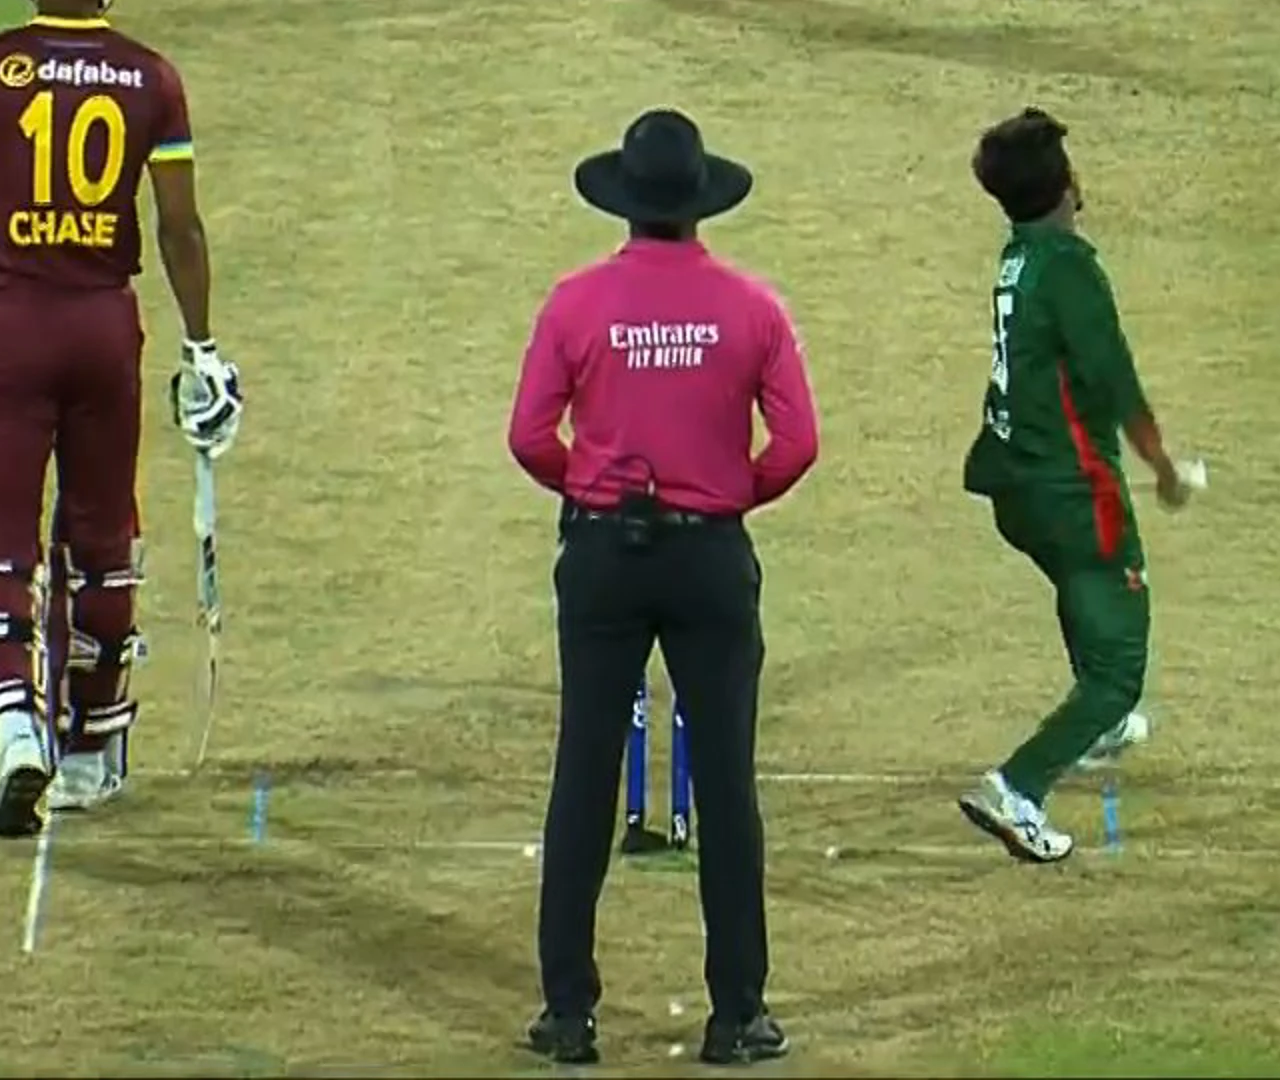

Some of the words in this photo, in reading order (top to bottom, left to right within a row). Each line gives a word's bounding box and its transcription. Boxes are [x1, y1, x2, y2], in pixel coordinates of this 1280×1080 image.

[37, 59, 143, 87] dafabet
[19, 90, 126, 206] 10
[9, 211, 118, 247] CHASE
[609, 320, 719, 349] Emirates
